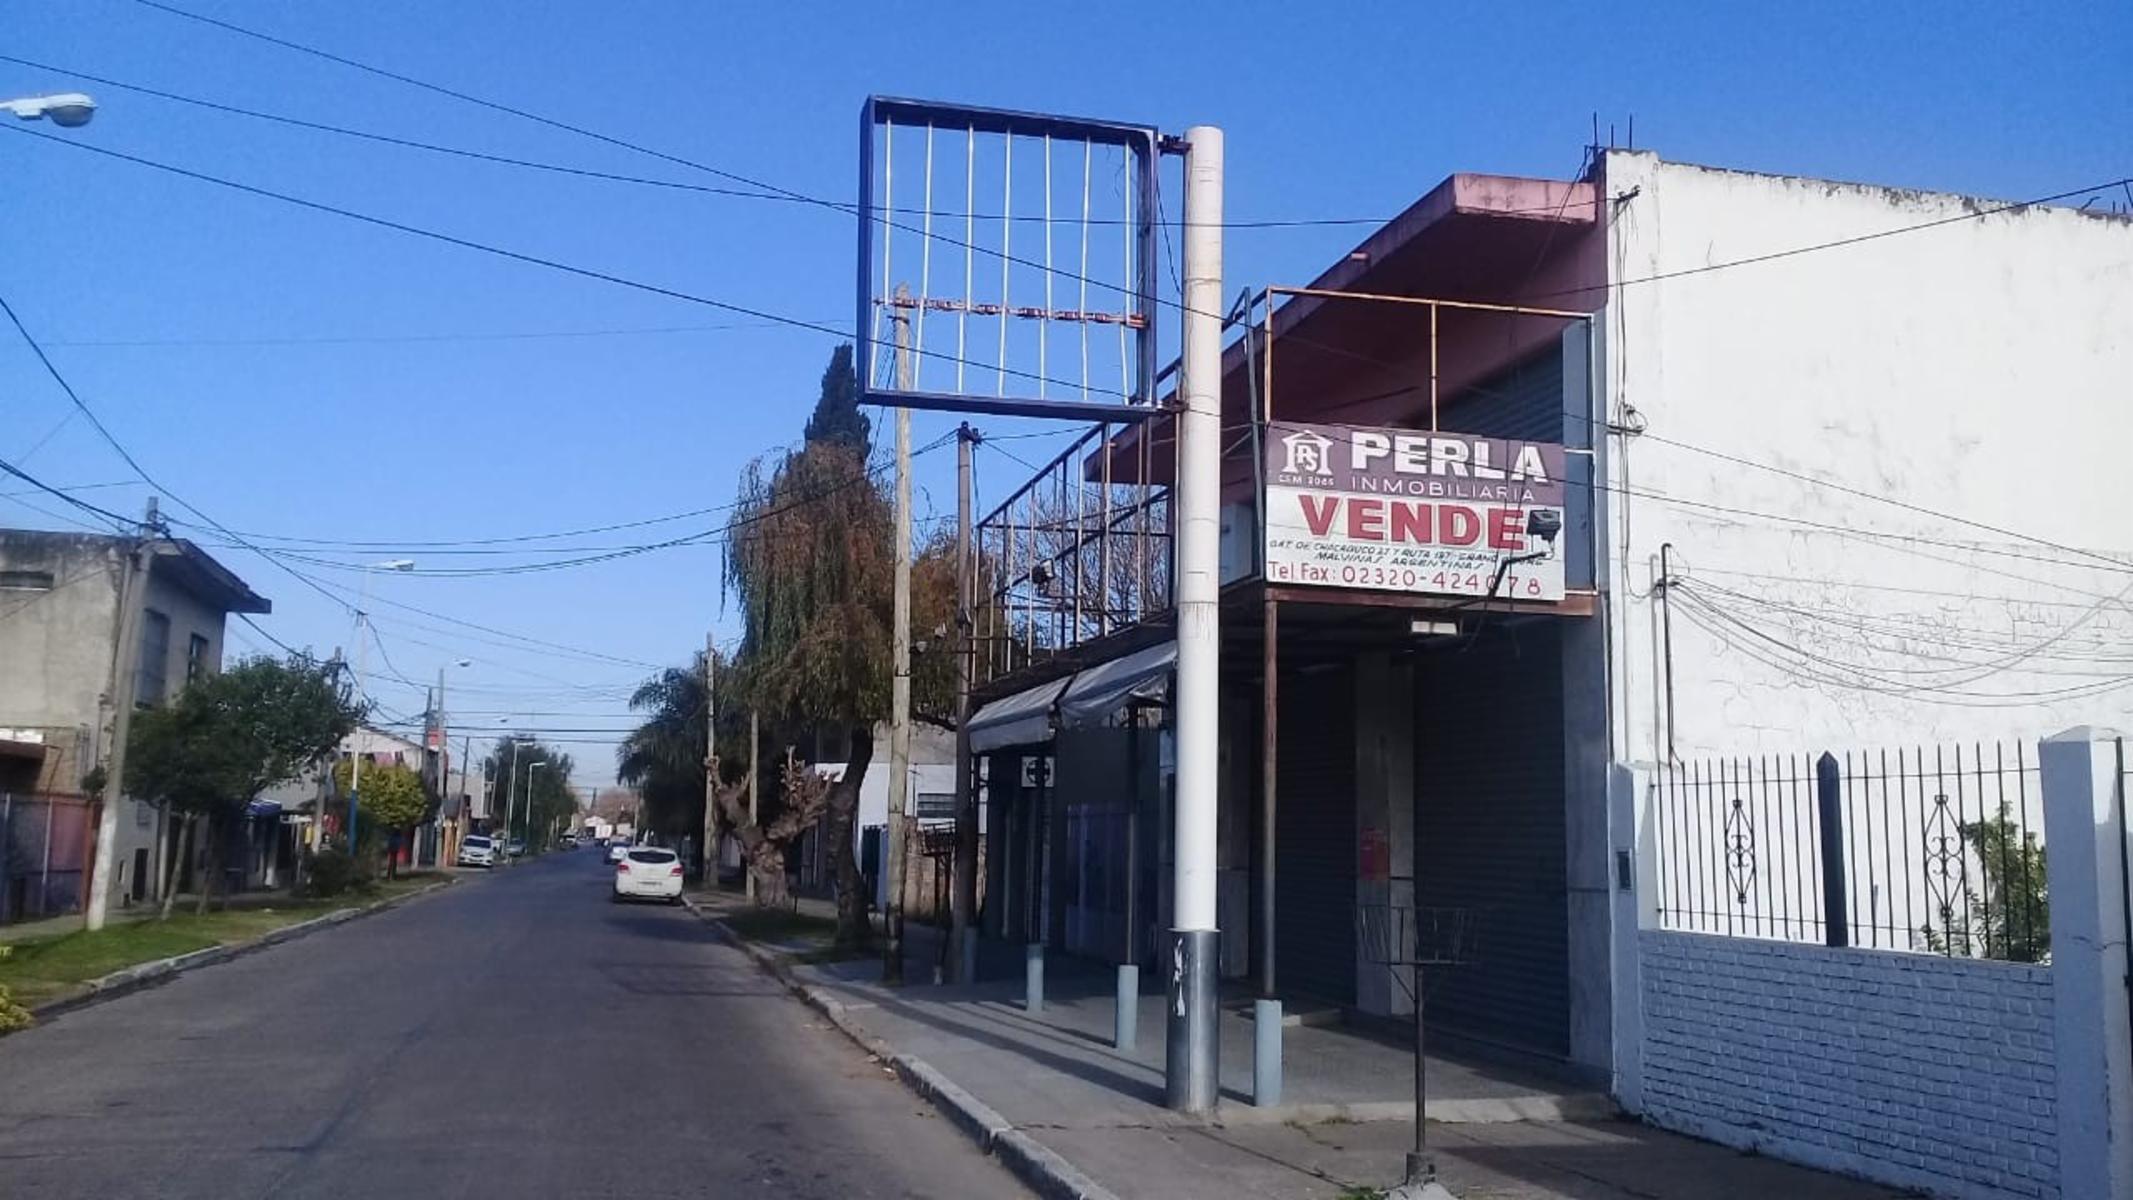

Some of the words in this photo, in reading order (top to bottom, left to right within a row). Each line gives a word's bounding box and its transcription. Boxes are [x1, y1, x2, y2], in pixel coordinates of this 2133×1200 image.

[1352, 431, 1548, 482] PERLA
[1352, 476, 1535, 501] INMOBILIARIA
[1298, 495, 1524, 550] VENDE
[1314, 551, 1384, 564] MALVINAS
[1390, 557, 1484, 570] ARGENTINAS
